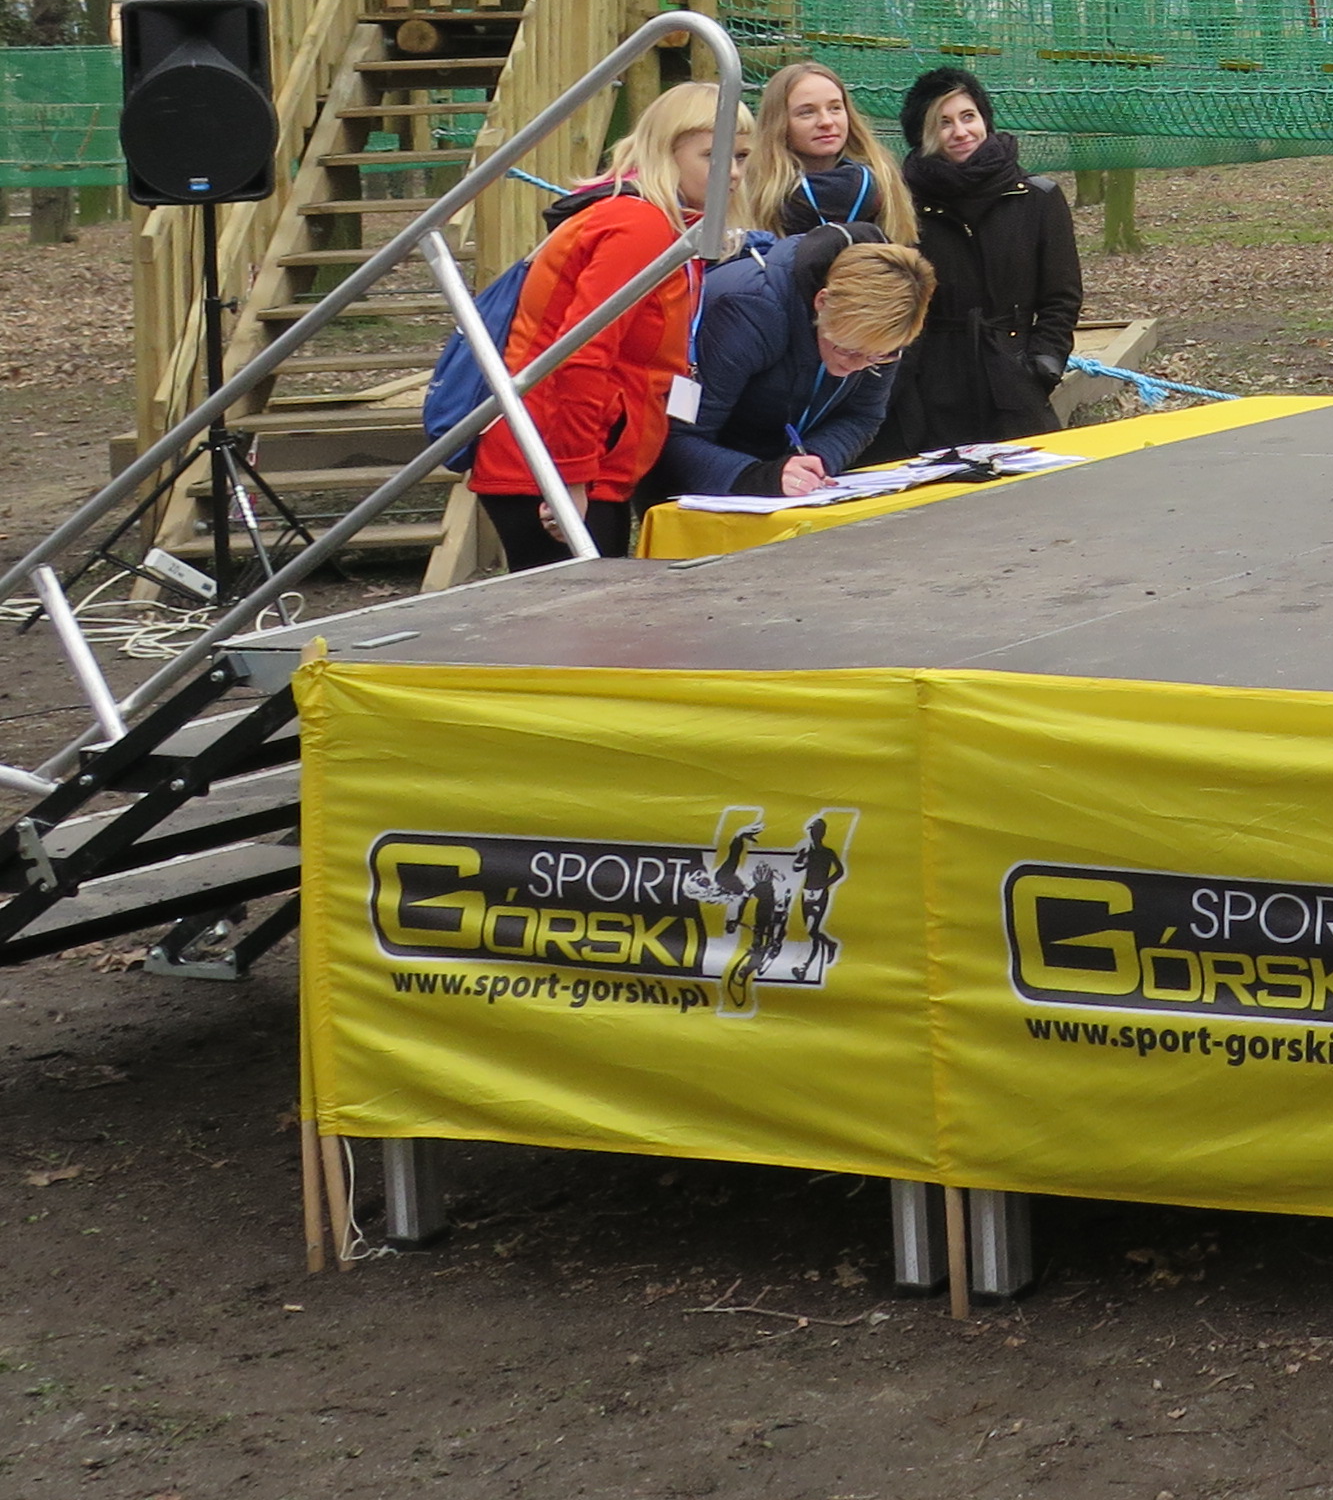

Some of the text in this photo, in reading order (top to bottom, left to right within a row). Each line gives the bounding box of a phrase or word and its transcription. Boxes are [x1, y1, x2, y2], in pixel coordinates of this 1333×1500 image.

[376, 841, 696, 969] GÓRSKI
[529, 850, 692, 906] SPORT
[391, 968, 710, 1013] www.sport-gorski.pl
